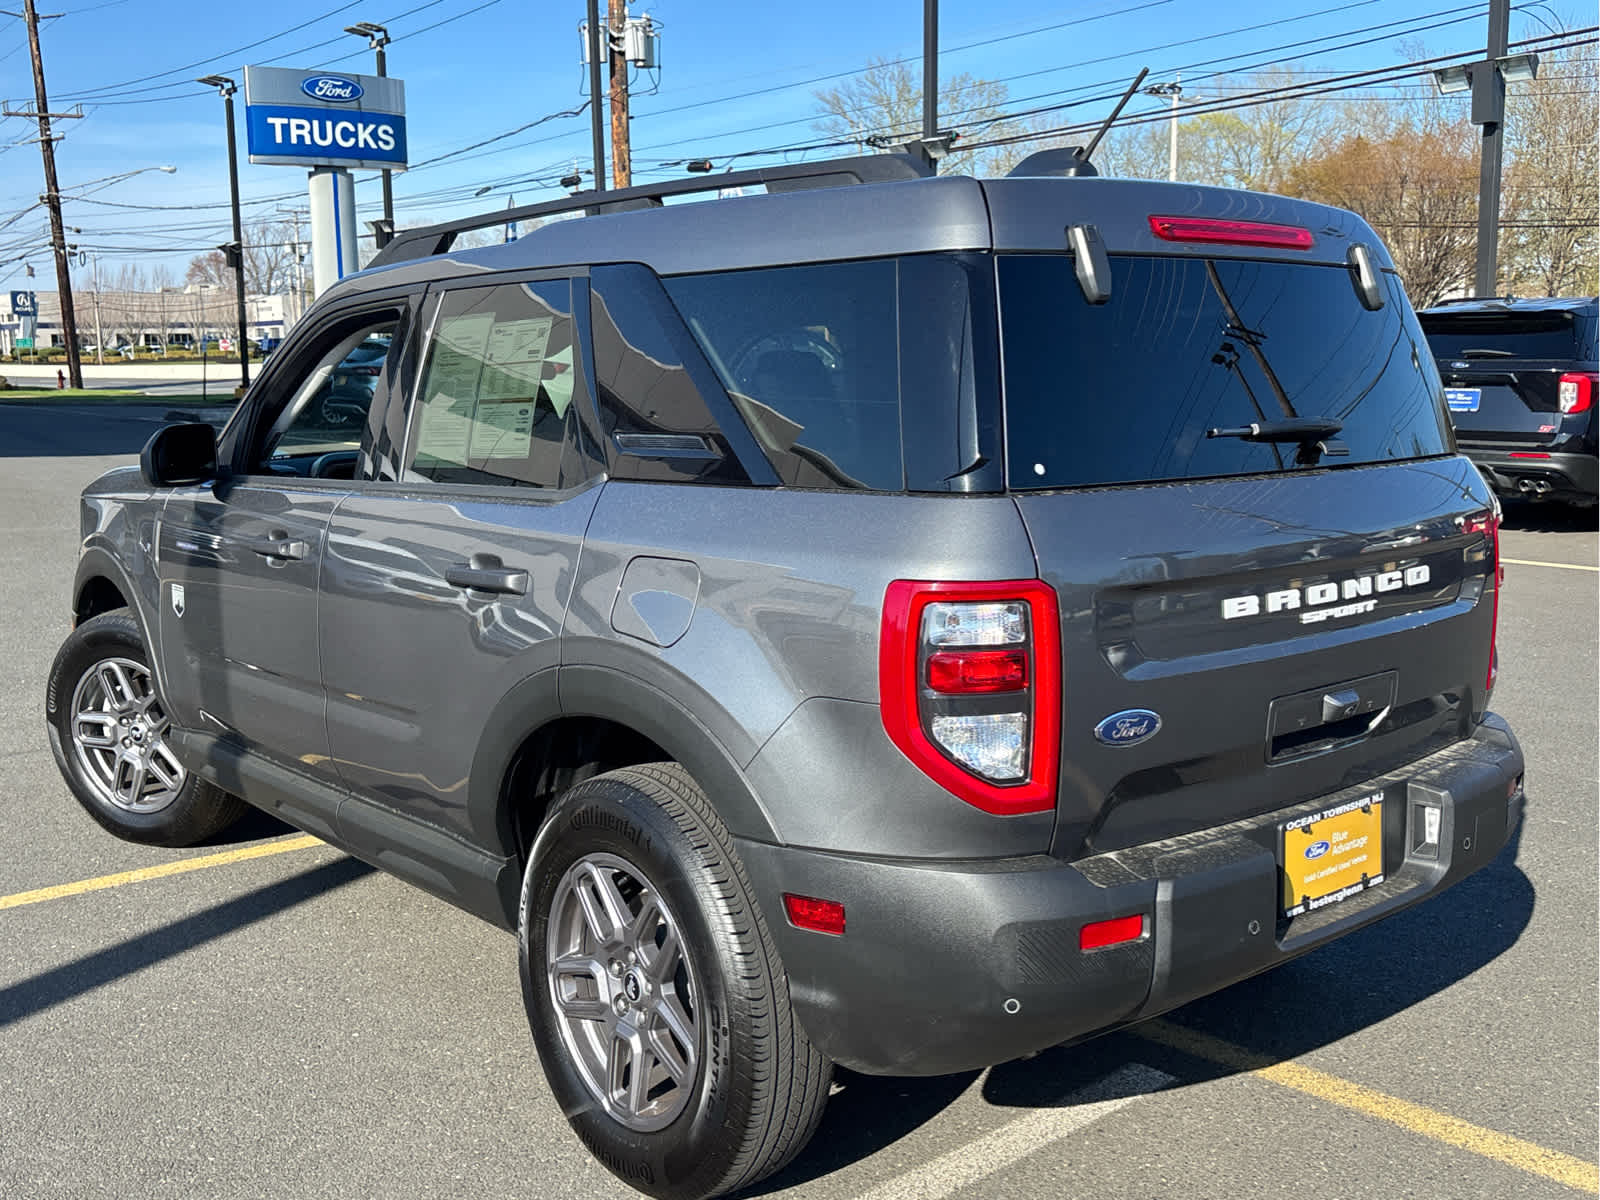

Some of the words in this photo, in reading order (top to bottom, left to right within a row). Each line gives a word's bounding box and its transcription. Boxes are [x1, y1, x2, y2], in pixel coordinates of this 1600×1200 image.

[314, 79, 353, 98] Ford
[267, 117, 395, 151] TRUCKS
[1222, 565, 1430, 620] BRONCO
[1300, 600, 1378, 625] SPORT
[1112, 718, 1149, 739] Ford
[1286, 812, 1321, 831] OCEAN
[1322, 797, 1371, 819] TOWNSHIP
[1371, 791, 1384, 804] NJ
[1332, 831, 1348, 843] Blue
[1332, 836, 1368, 856] Advantage
